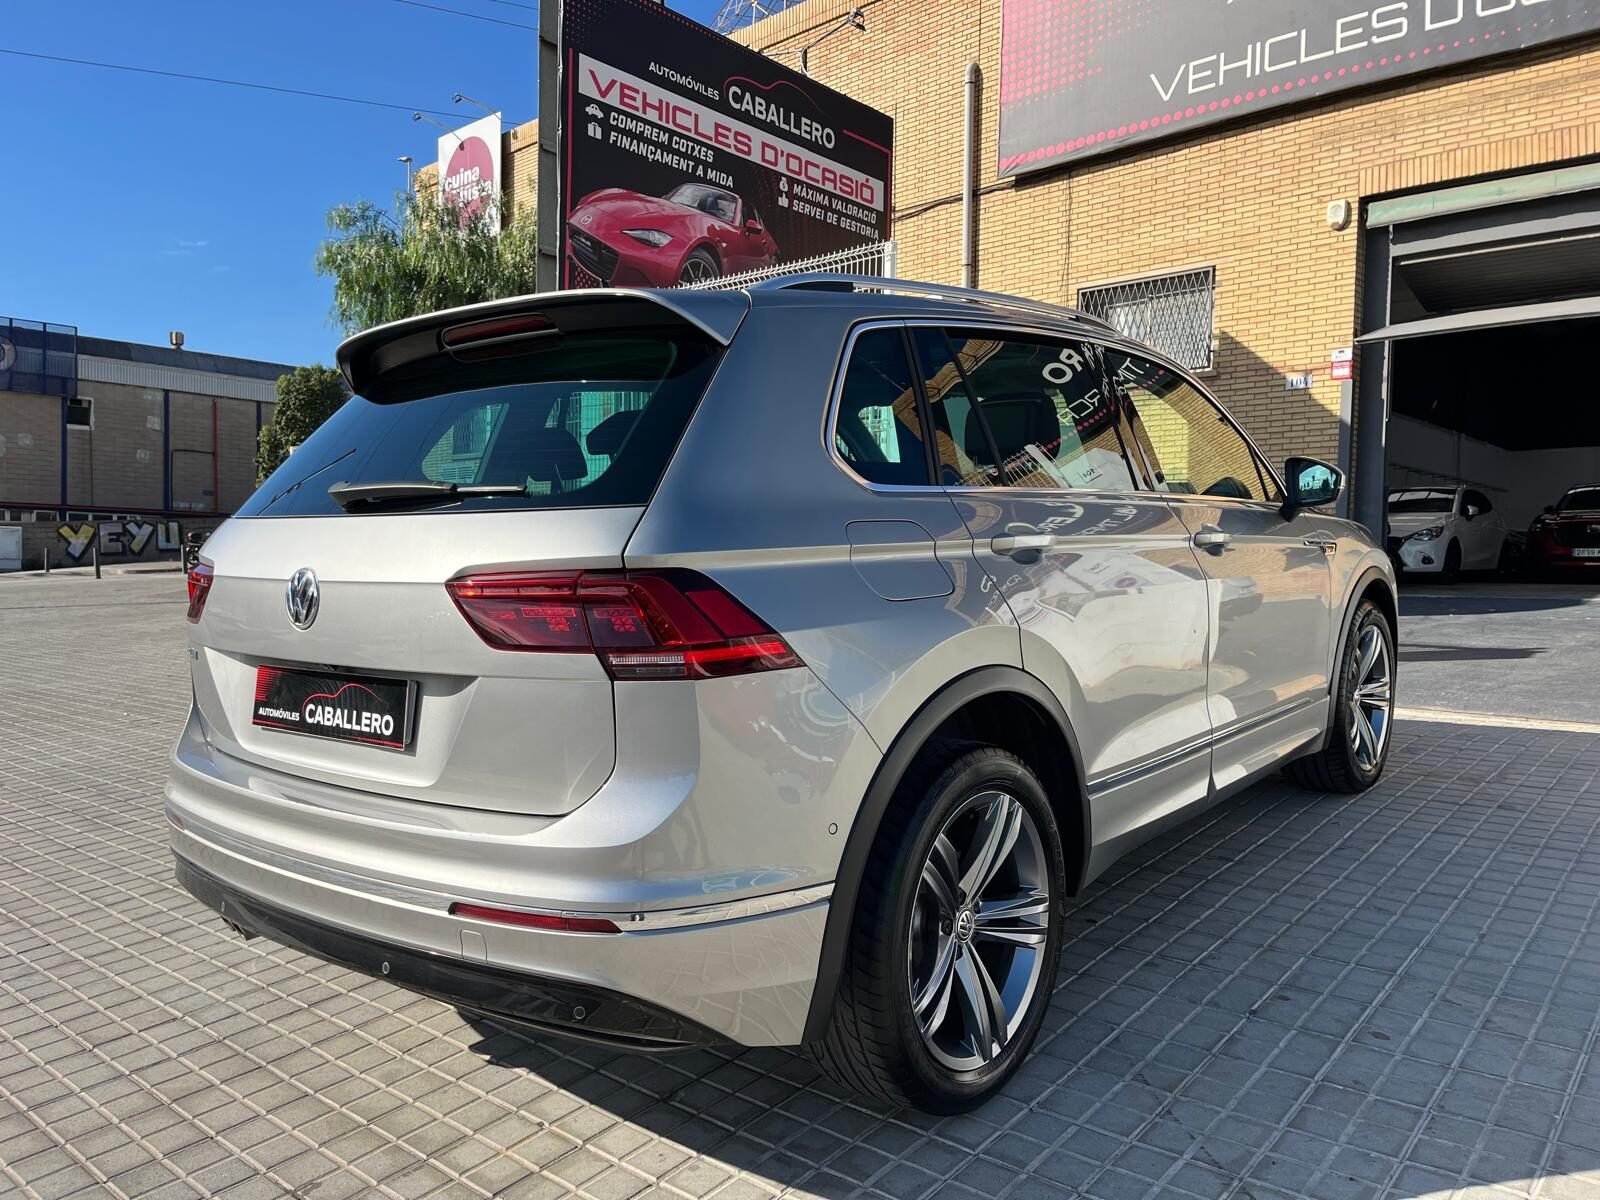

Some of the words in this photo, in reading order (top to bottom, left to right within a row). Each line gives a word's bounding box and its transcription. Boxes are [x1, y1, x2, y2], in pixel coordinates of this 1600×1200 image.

[1149, 2, 1409, 102] VEHICLES
[649, 61, 720, 101] AUTOMÓVILES
[728, 85, 836, 149] CABALLERO
[588, 68, 752, 157] VEHICLES
[761, 141, 875, 205] D'OCASIÓ
[610, 111, 669, 145] COMPREM
[672, 136, 714, 162] COTXES
[445, 166, 480, 192] cuina
[609, 131, 695, 173] FINANÇAMENT
[696, 164, 704, 178] A
[706, 168, 734, 188] MIDA
[792, 200, 825, 220] SERVEI
[827, 212, 839, 226] DE
[840, 216, 880, 240] GESTORIA
[793, 184, 830, 207] MÀXIMA
[831, 198, 877, 224] VALORACIÓ
[1290, 376, 1308, 388] 104
[258, 706, 300, 722] AUTOMÓVILES
[304, 703, 394, 736] CABALLERO
